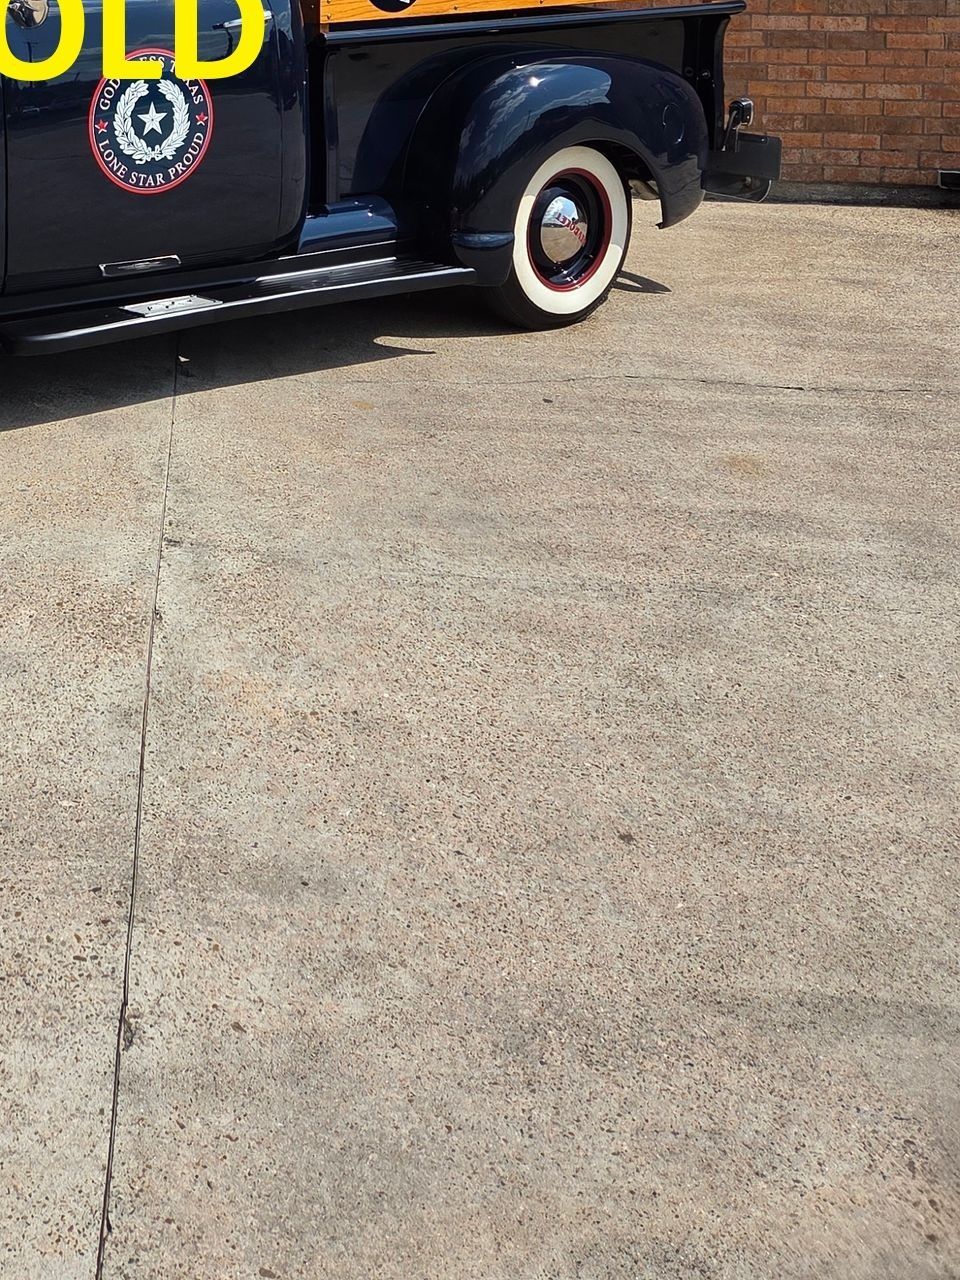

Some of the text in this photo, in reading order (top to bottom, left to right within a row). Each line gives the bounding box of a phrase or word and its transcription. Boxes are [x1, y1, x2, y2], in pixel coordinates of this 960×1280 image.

[99, 77, 121, 111] GOD
[98, 132, 204, 187] LONE STAR PROUD
